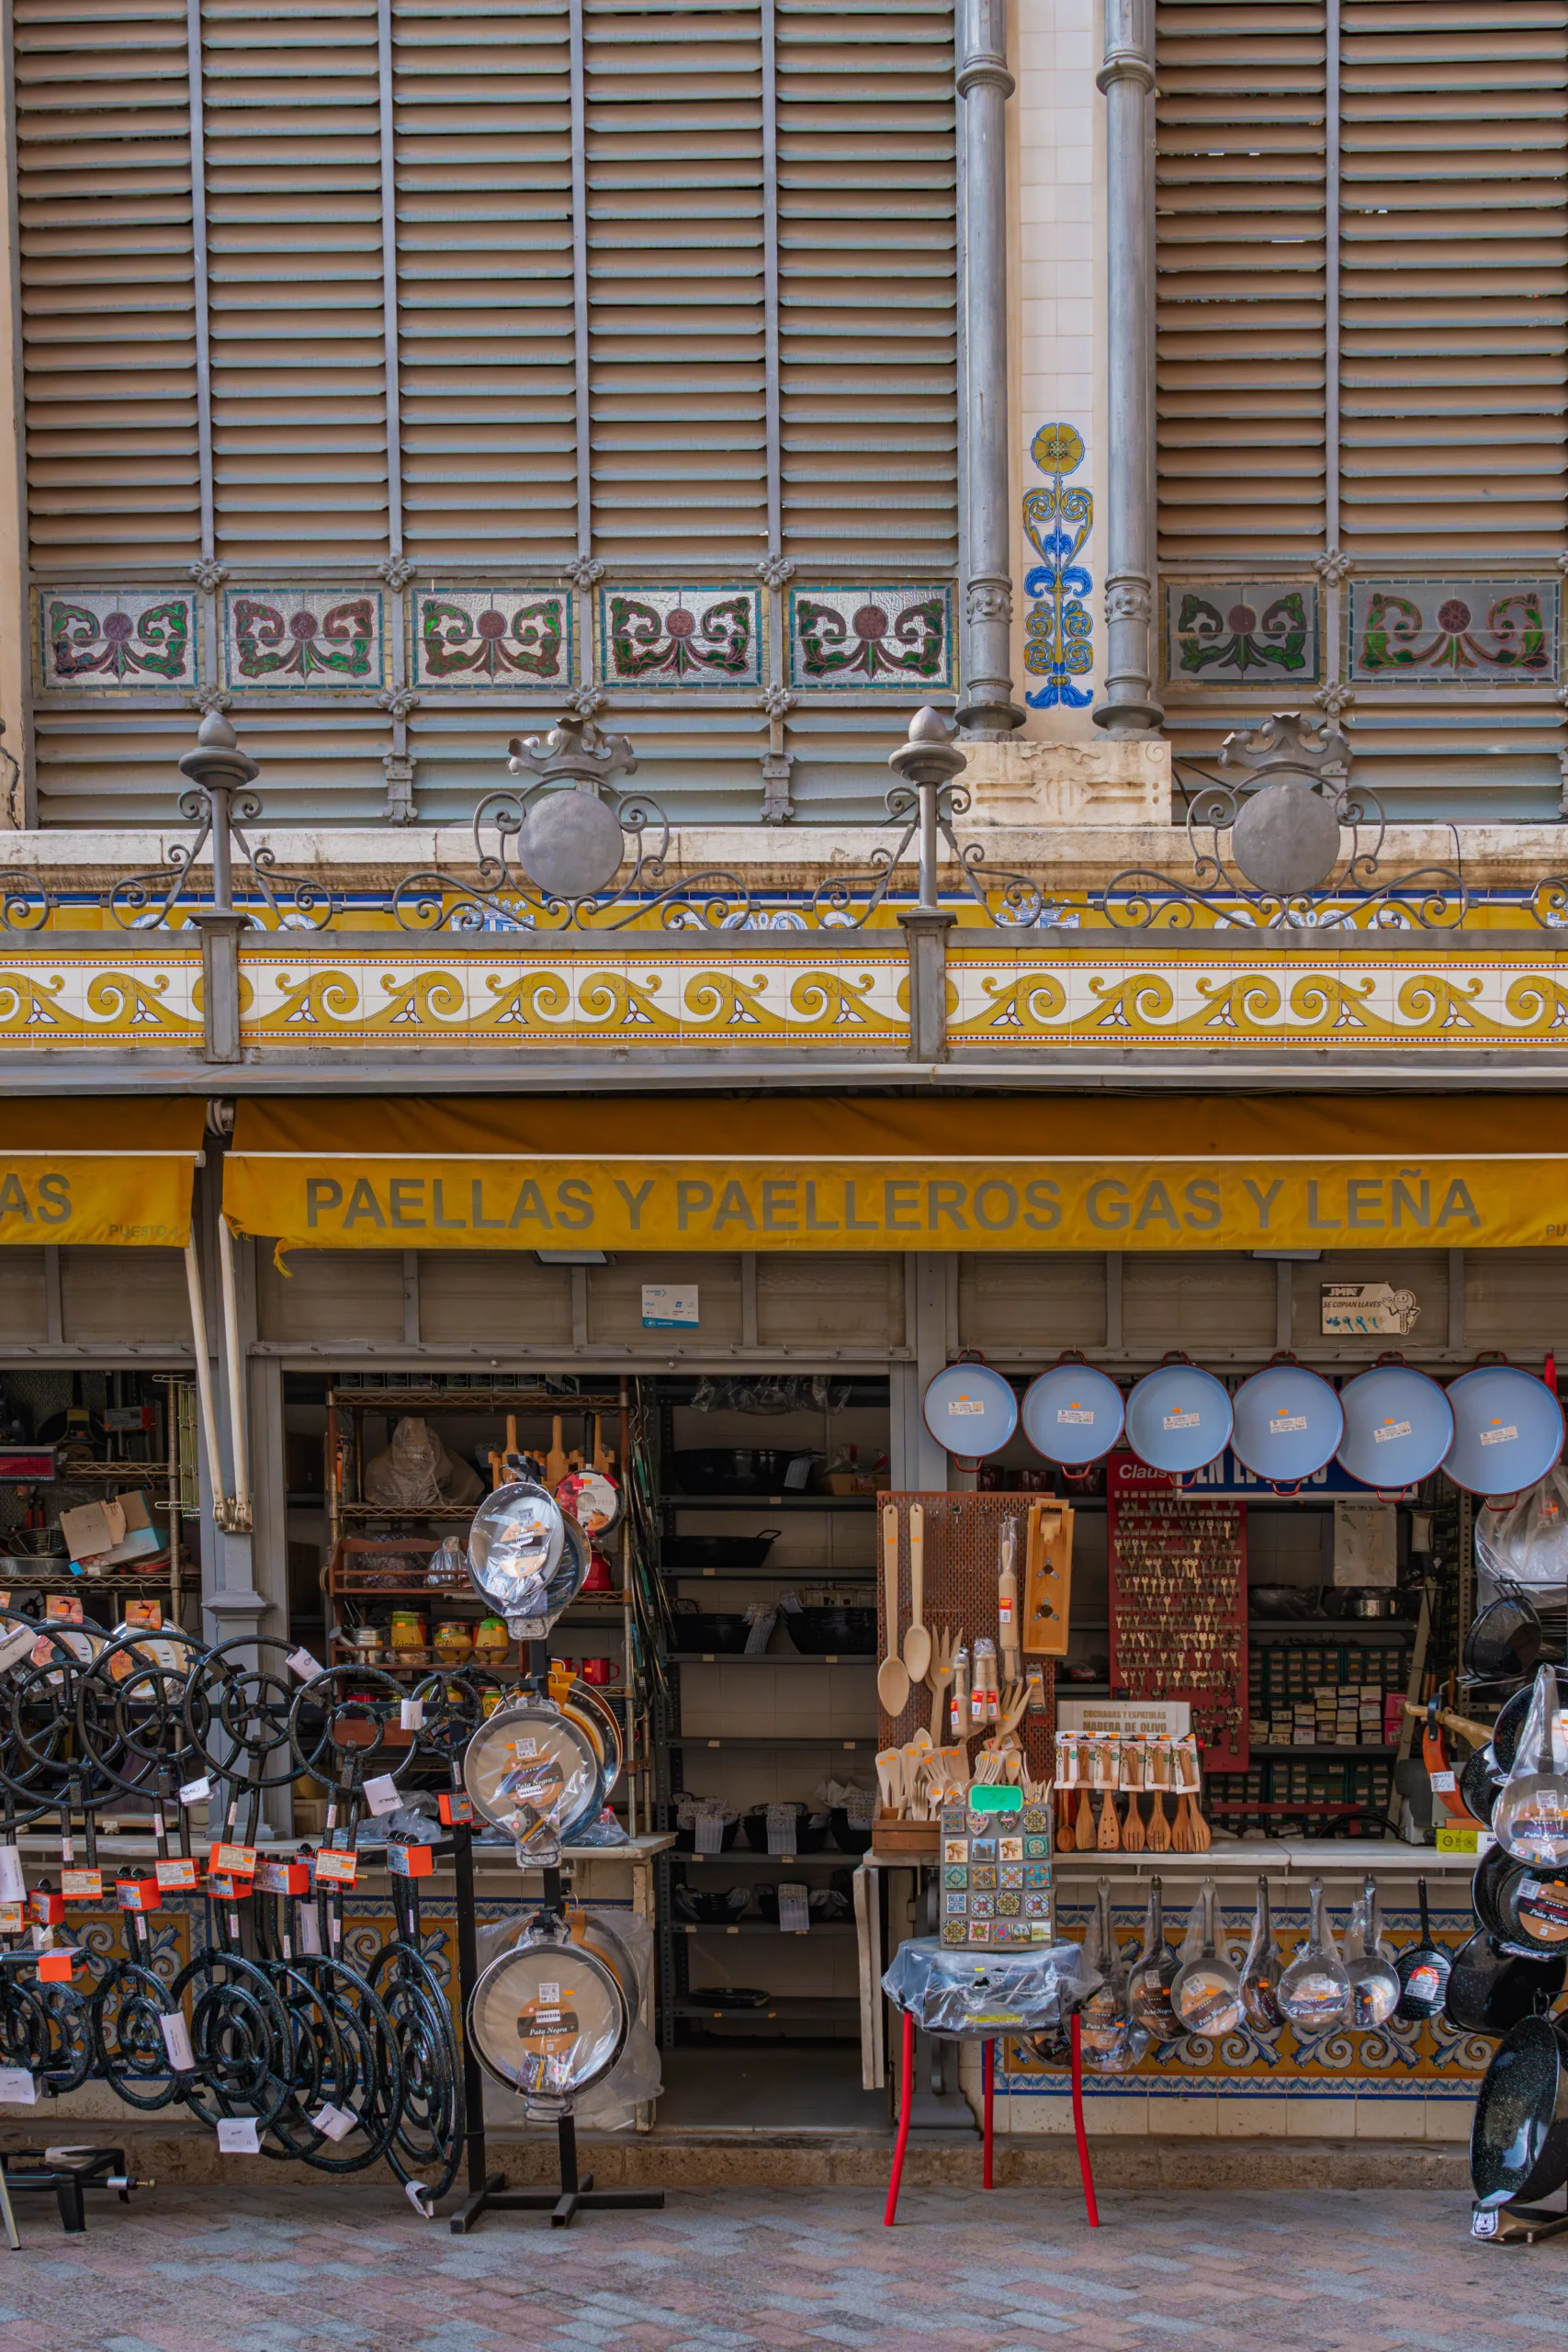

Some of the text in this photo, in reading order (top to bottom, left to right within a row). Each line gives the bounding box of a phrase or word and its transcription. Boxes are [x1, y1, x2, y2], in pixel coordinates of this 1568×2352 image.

[306, 1168, 1483, 1232] PAELLAS Y PAELLEROS GAS Y LEÑA
[108, 1225, 167, 1238] PUESTO
[1328, 1288, 1357, 1296] JMA
[1082, 1721, 1168, 1733] MADERA DE OLIVO
[515, 1777, 553, 1791] Pata Negra
[1529, 1908, 1568, 1926] Pata Negra
[1198, 2005, 1227, 2026] Pata Negra
[529, 2026, 568, 2036] Pata Negra
[1051, 2044, 1064, 2054] Pata
